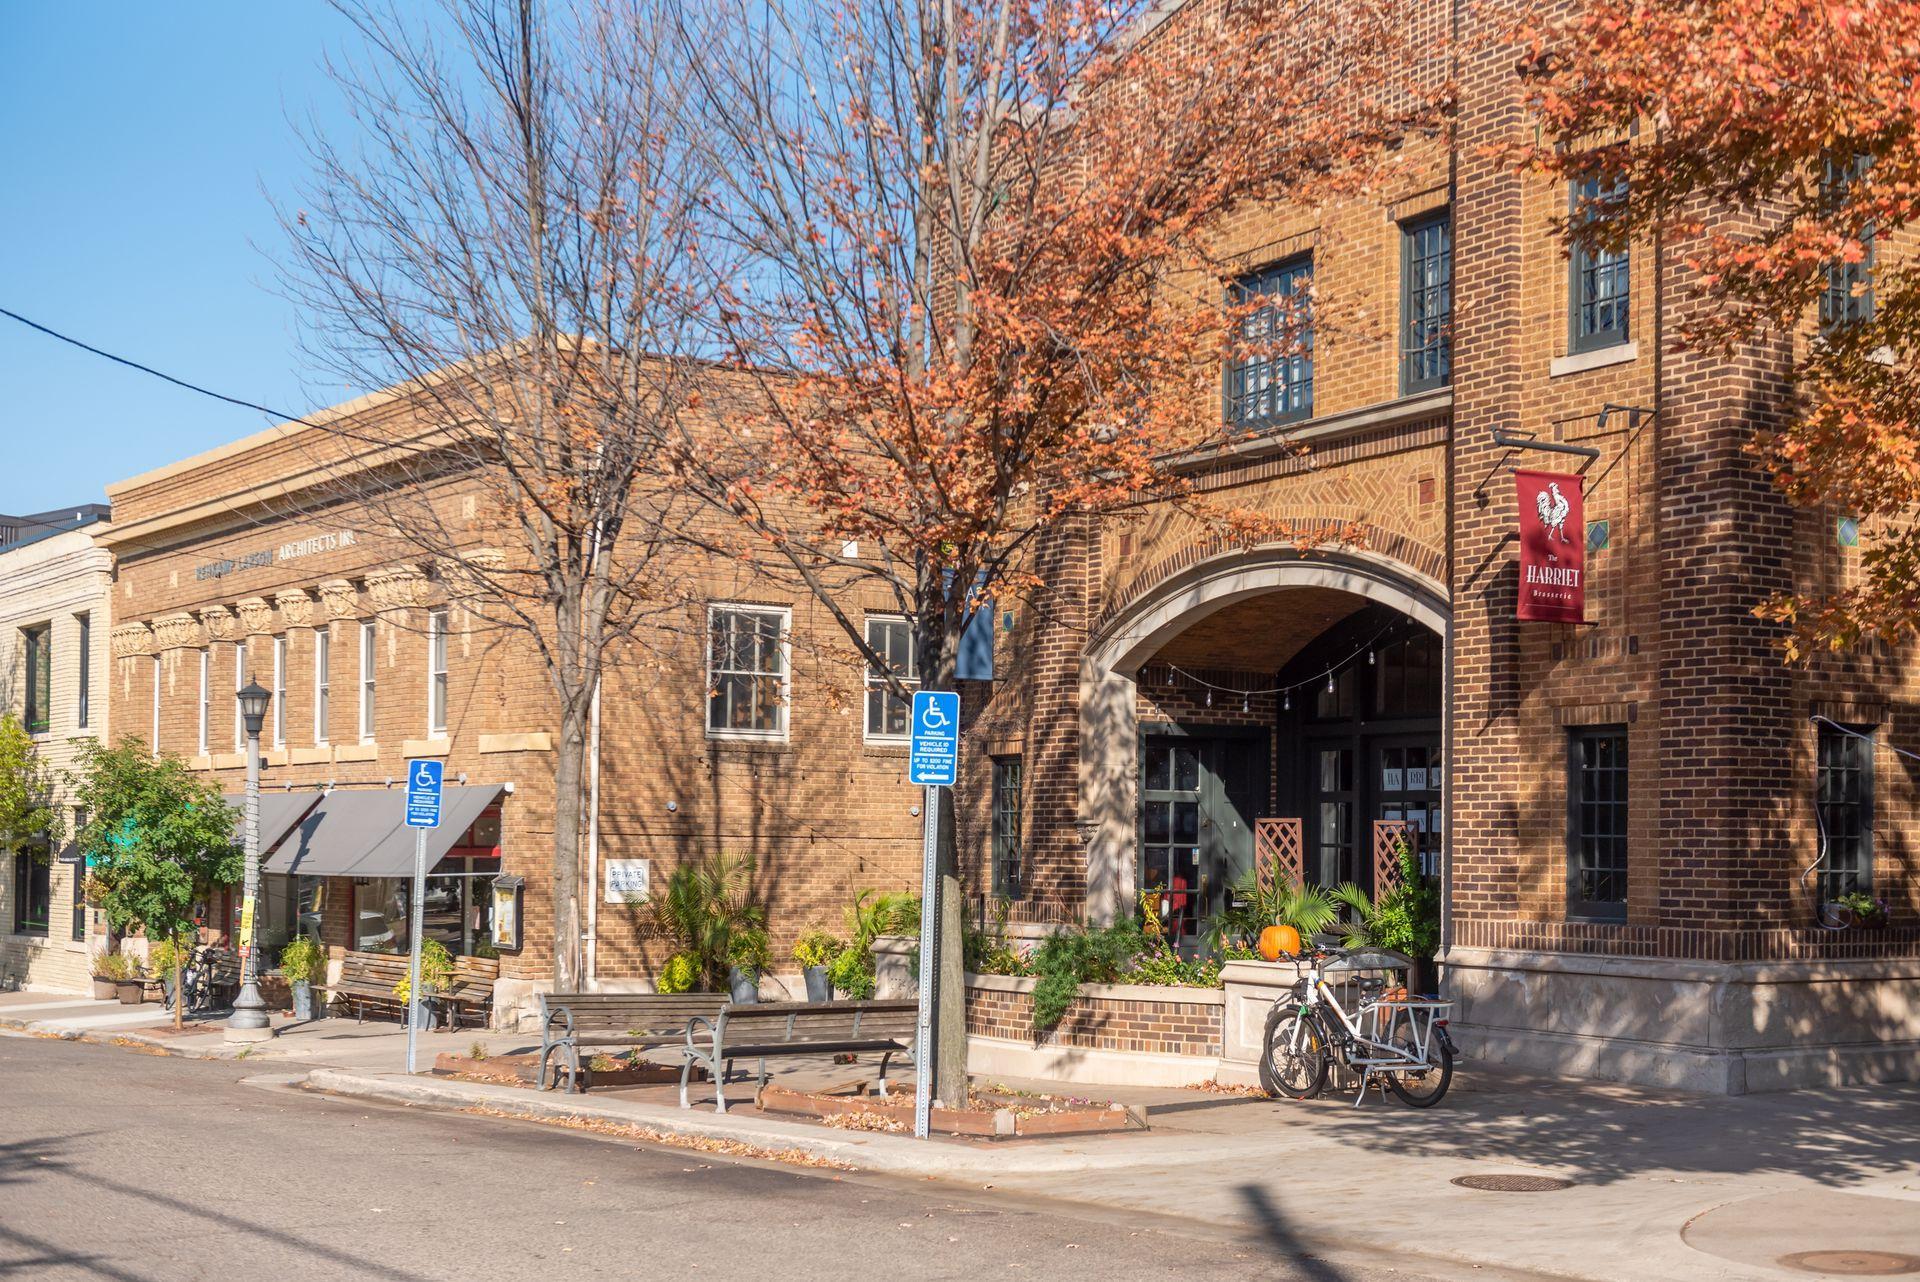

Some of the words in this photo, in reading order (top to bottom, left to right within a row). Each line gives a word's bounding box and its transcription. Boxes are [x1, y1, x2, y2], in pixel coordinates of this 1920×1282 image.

[278, 532, 336, 561] ARCHITECTS
[1547, 554, 1558, 562] The
[1526, 565, 1580, 587] HARRIET
[1533, 589, 1572, 600] Brasserie
[612, 870, 641, 879] PRIVATE
[610, 880, 642, 889] PARKING
